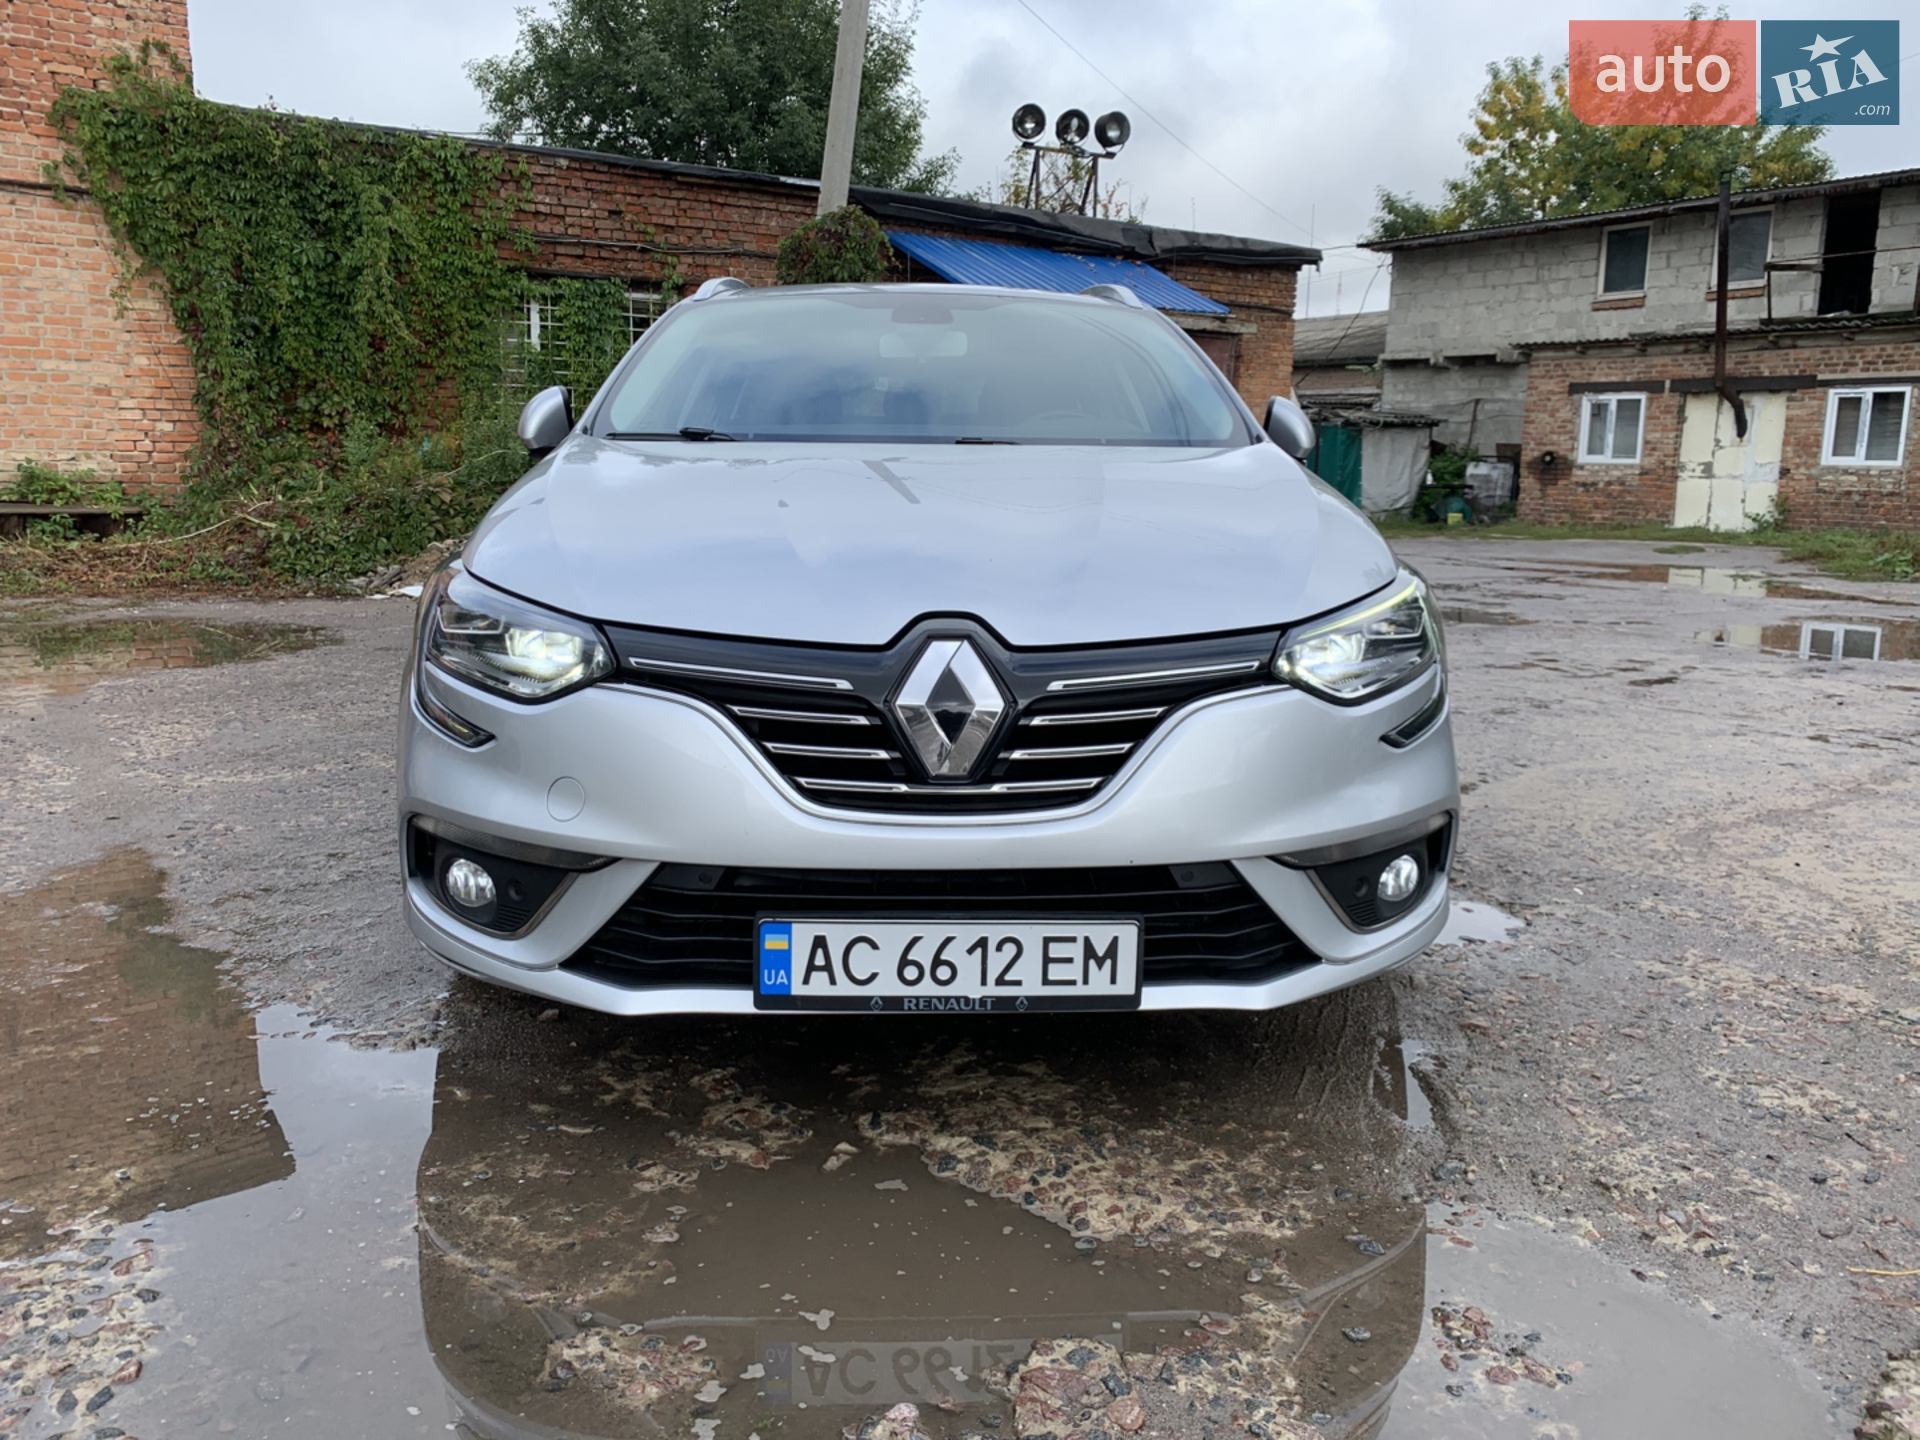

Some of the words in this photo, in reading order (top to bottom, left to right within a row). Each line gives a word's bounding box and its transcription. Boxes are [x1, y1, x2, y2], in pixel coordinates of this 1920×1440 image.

[802, 934, 881, 986] AC
[896, 935, 1024, 987] 6612
[1041, 935, 1119, 986] EM
[764, 969, 788, 985] UA
[903, 997, 996, 1011] RENAULT
